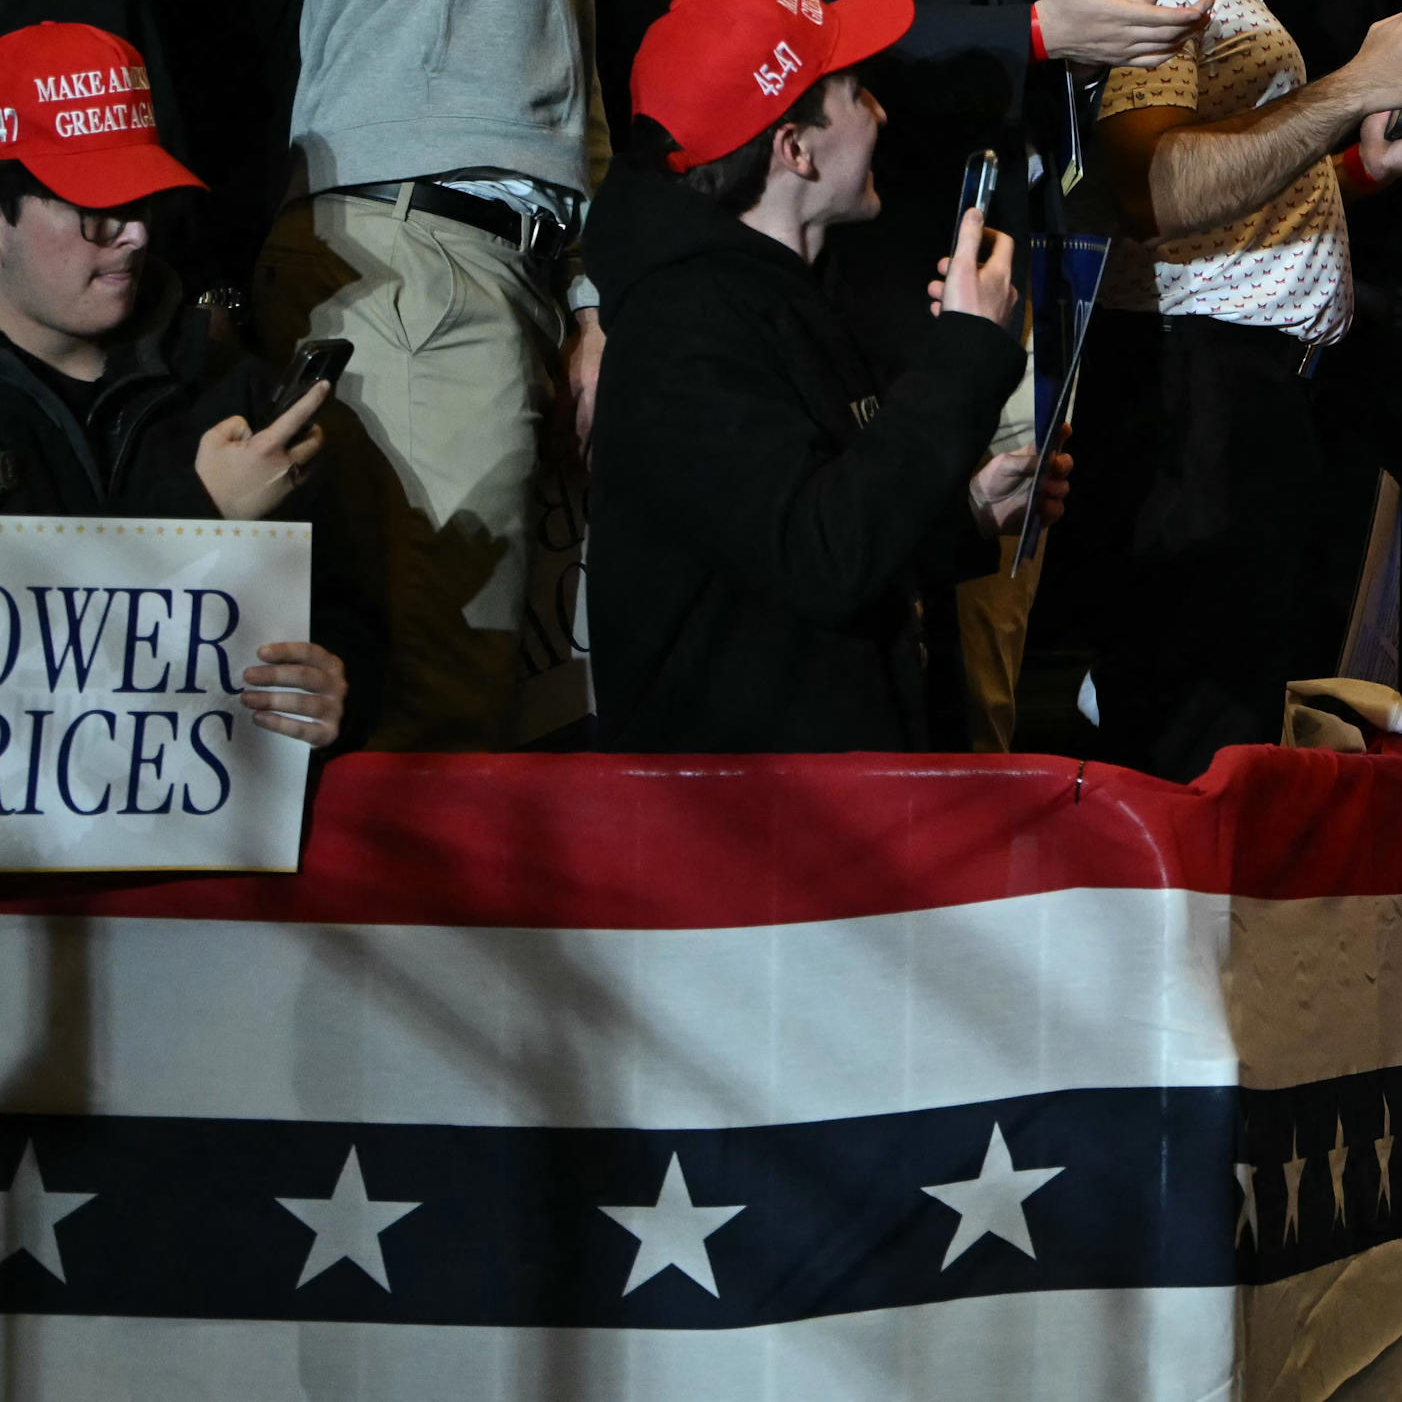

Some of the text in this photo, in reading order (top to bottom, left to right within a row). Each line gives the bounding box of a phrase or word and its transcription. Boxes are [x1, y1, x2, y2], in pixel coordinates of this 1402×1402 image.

[34, 70, 105, 103] MAKE
[753, 41, 802, 96] 45-47
[55, 102, 156, 138] GREAT AGA
[0, 709, 234, 816] ICES
